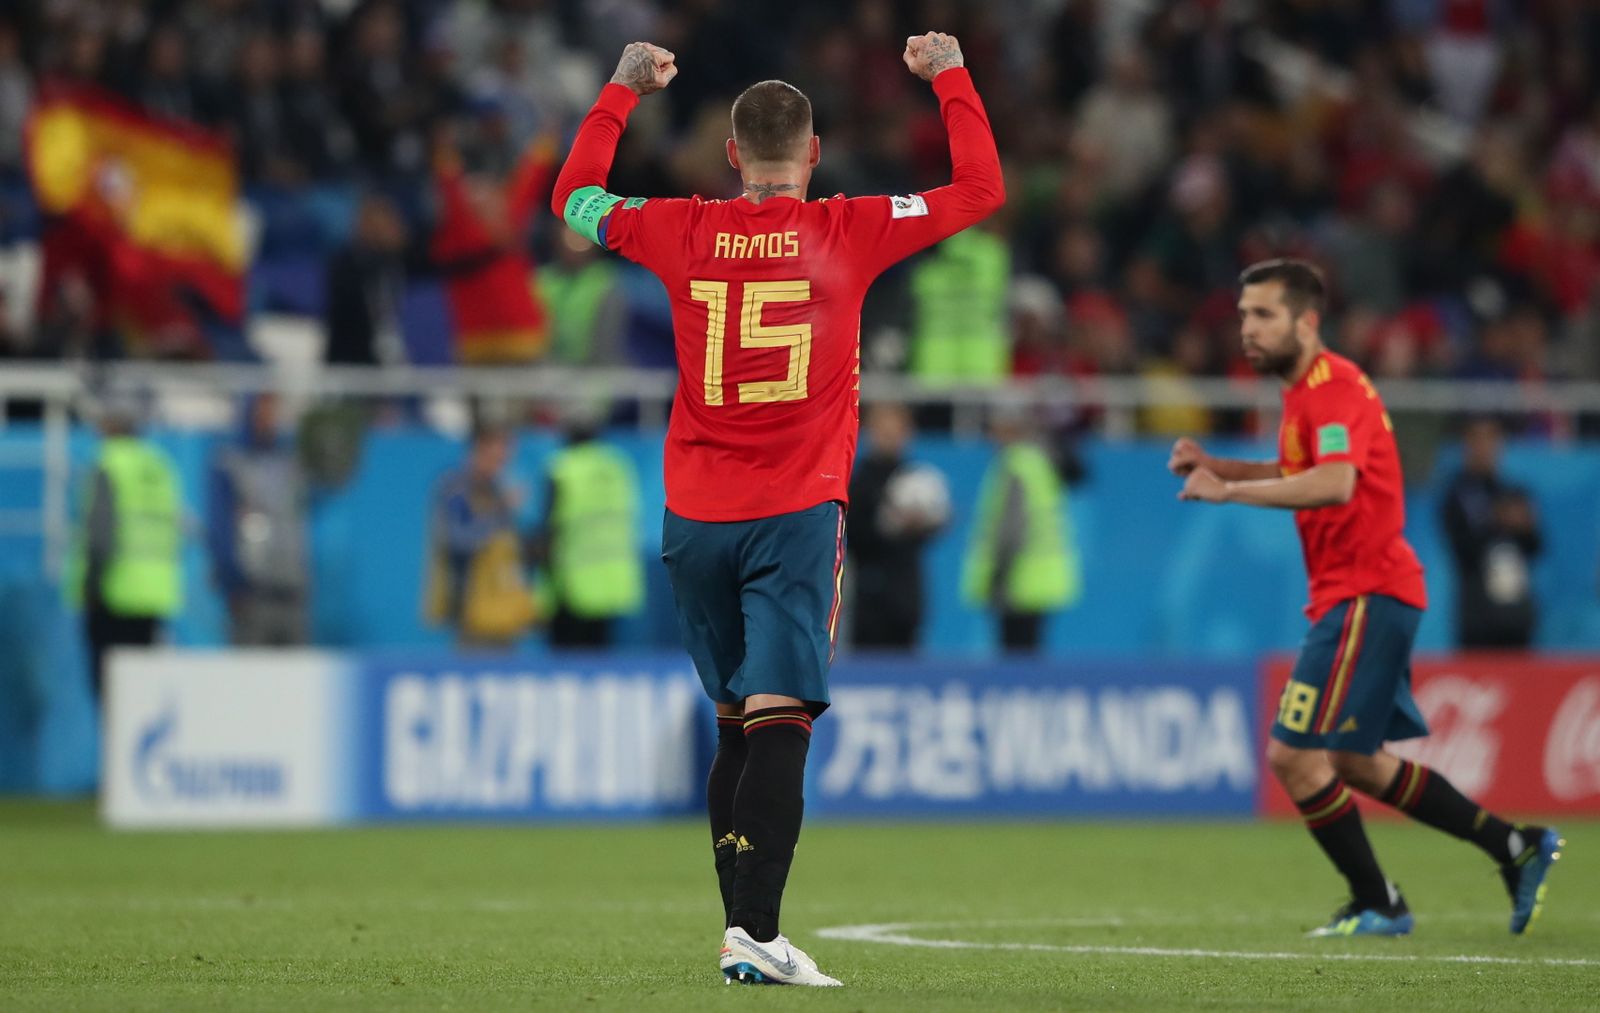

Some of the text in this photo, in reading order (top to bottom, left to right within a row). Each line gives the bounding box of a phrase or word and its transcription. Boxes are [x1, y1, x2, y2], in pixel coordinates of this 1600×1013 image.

[570, 197, 584, 217] FIFA
[714, 231, 799, 259] RAMOS
[690, 280, 812, 406] 15
[984, 685, 1256, 794] WANDA
